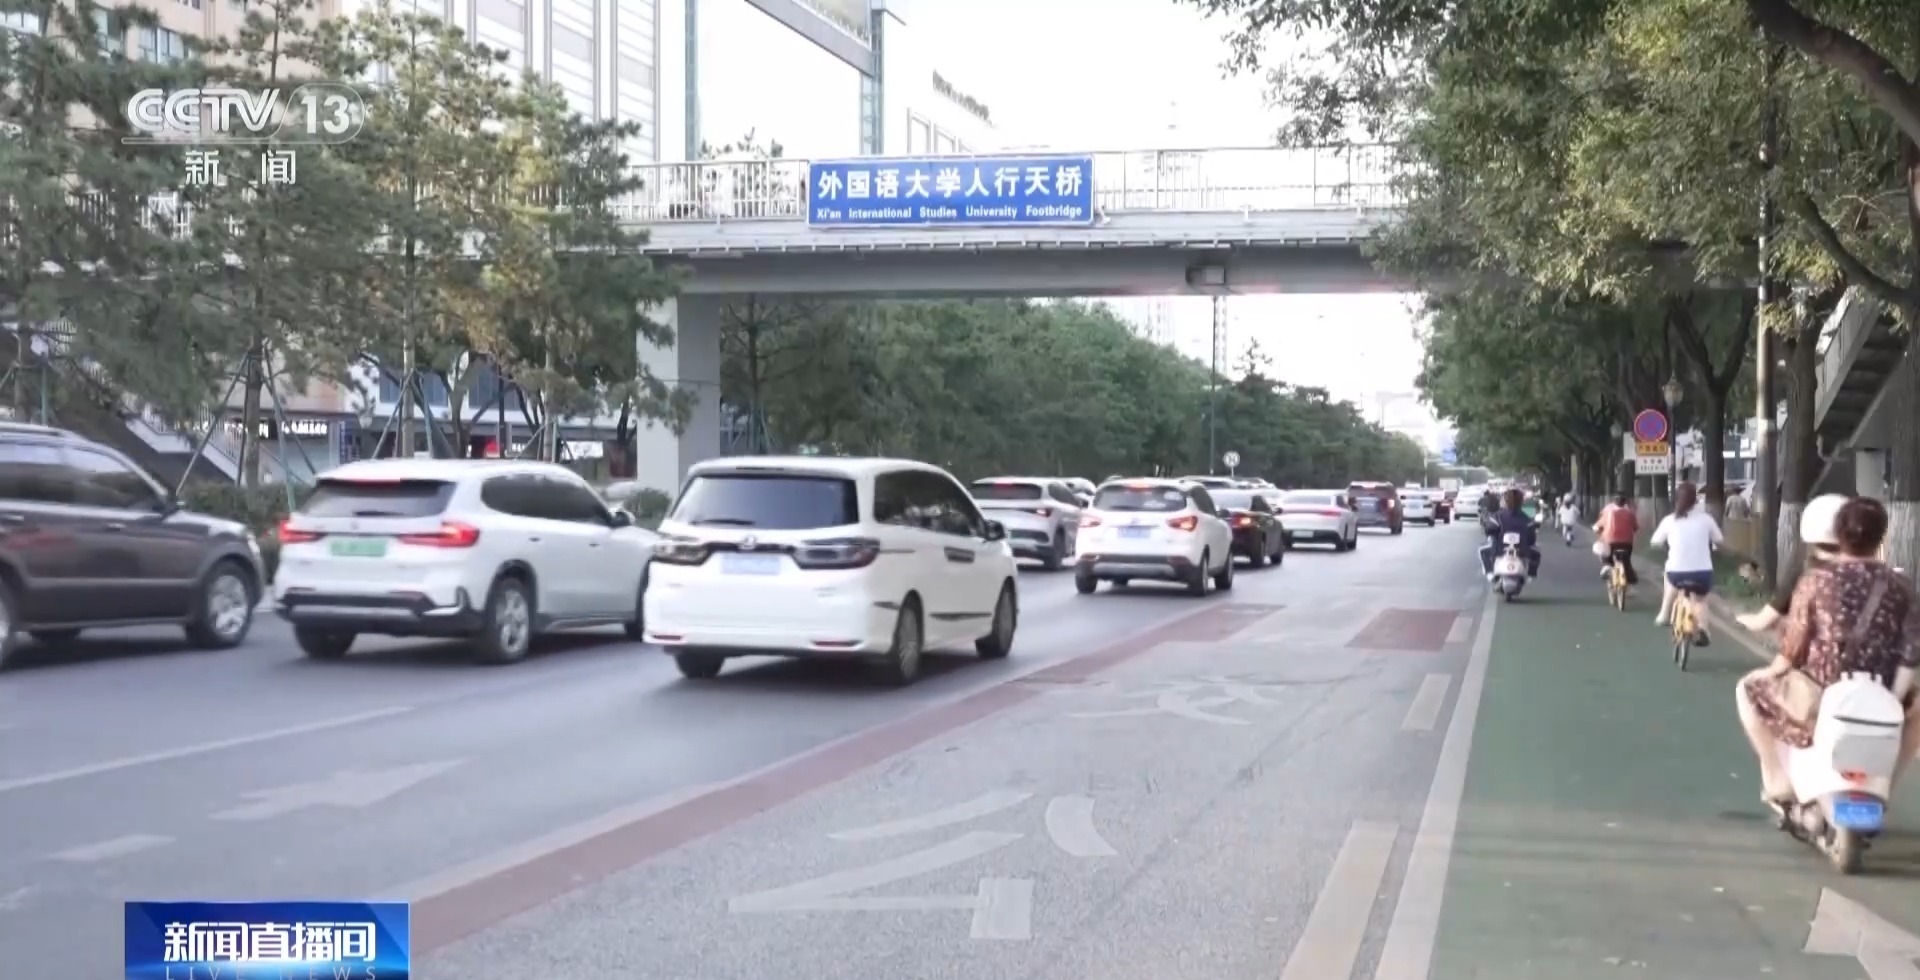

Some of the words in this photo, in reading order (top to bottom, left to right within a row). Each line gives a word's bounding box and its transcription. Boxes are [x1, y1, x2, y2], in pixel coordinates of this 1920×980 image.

[817, 165, 1083, 199] 外国语大学人行天桥
[817, 208, 841, 218] Xi'an
[849, 207, 911, 218] International
[919, 206, 957, 218] Studies
[966, 205, 1017, 218] University
[1026, 204, 1082, 218] Footbridge
